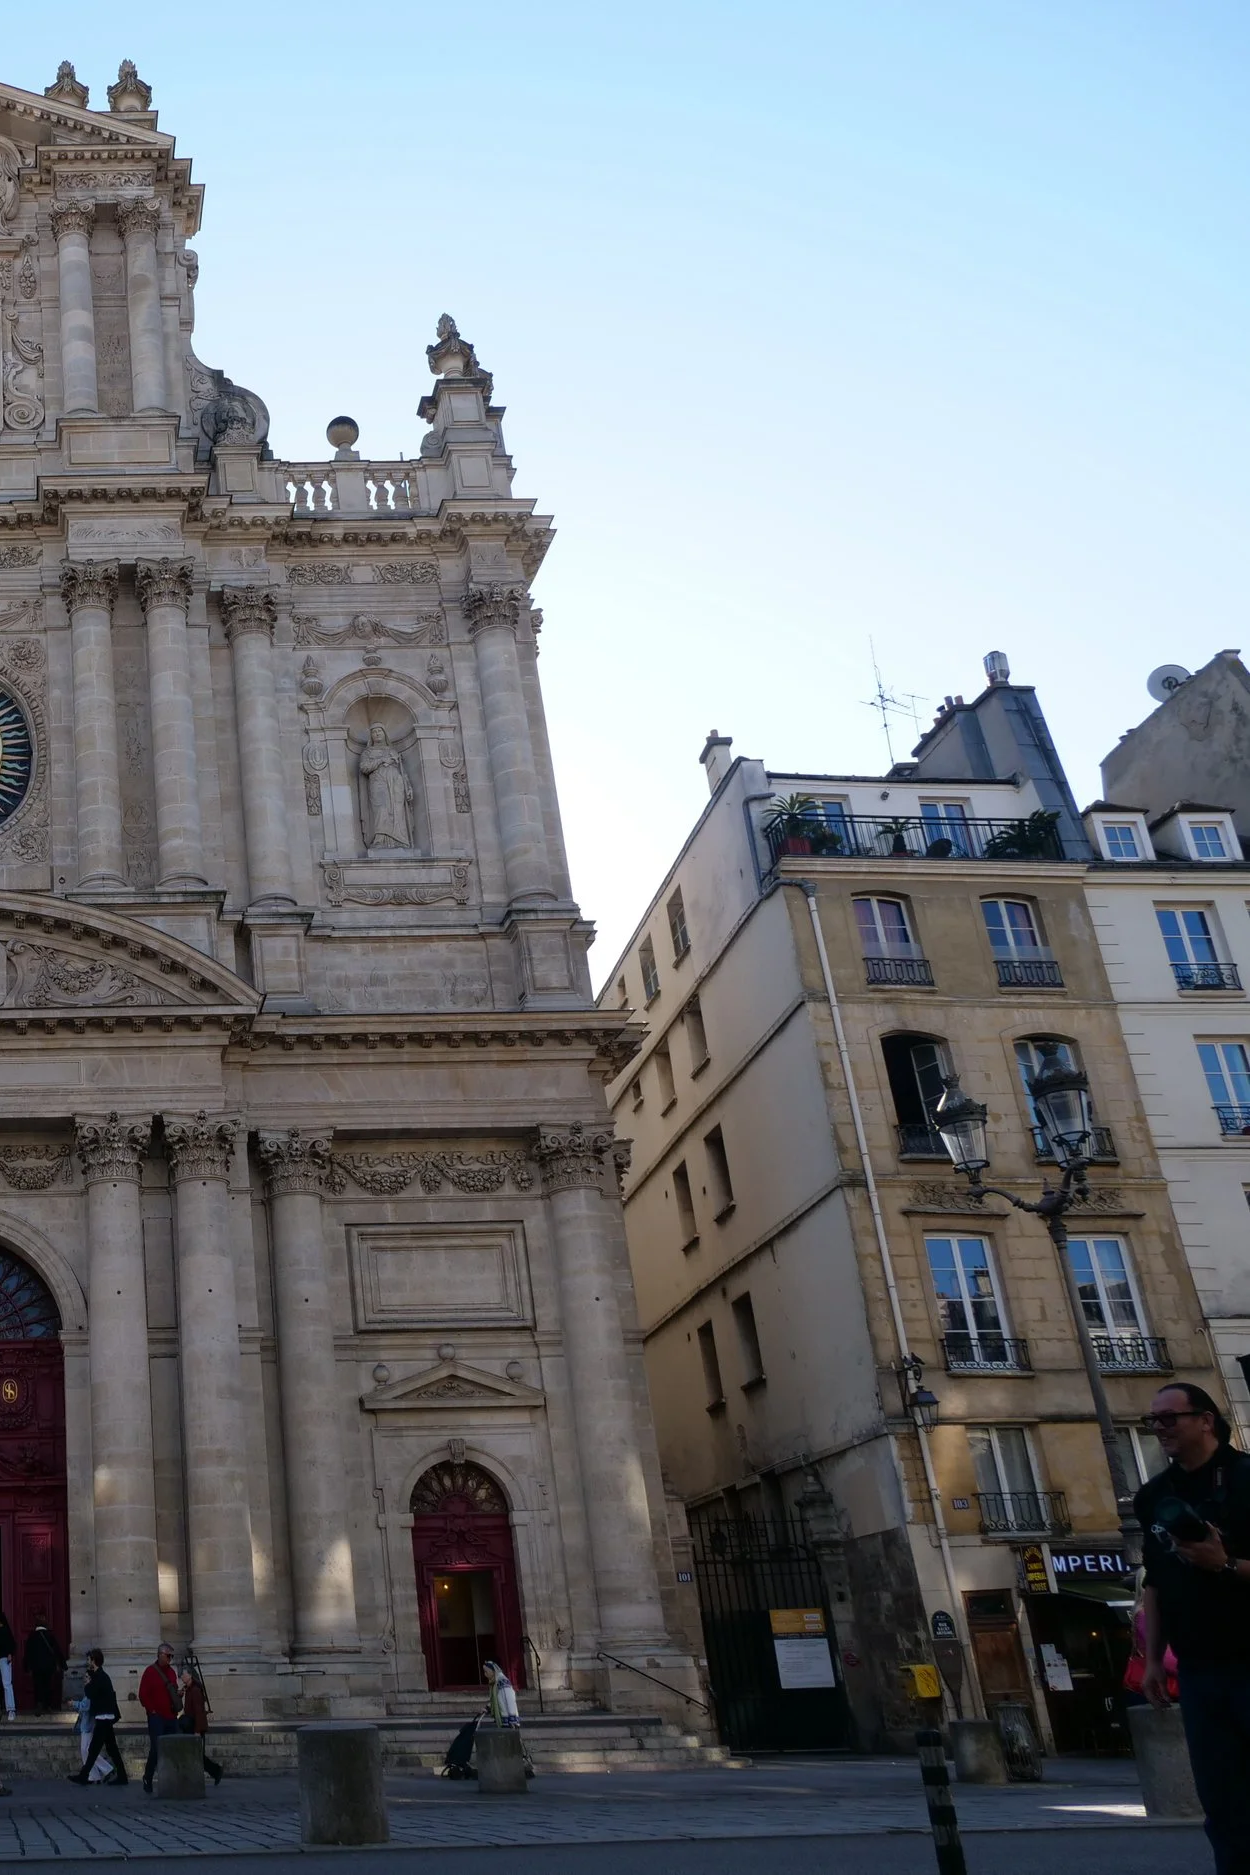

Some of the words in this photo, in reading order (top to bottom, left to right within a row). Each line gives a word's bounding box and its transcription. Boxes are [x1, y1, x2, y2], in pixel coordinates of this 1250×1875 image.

[953, 1499, 968, 1509] 103
[1052, 1555, 1130, 1573] MPERI
[678, 1572, 691, 1582] 101
